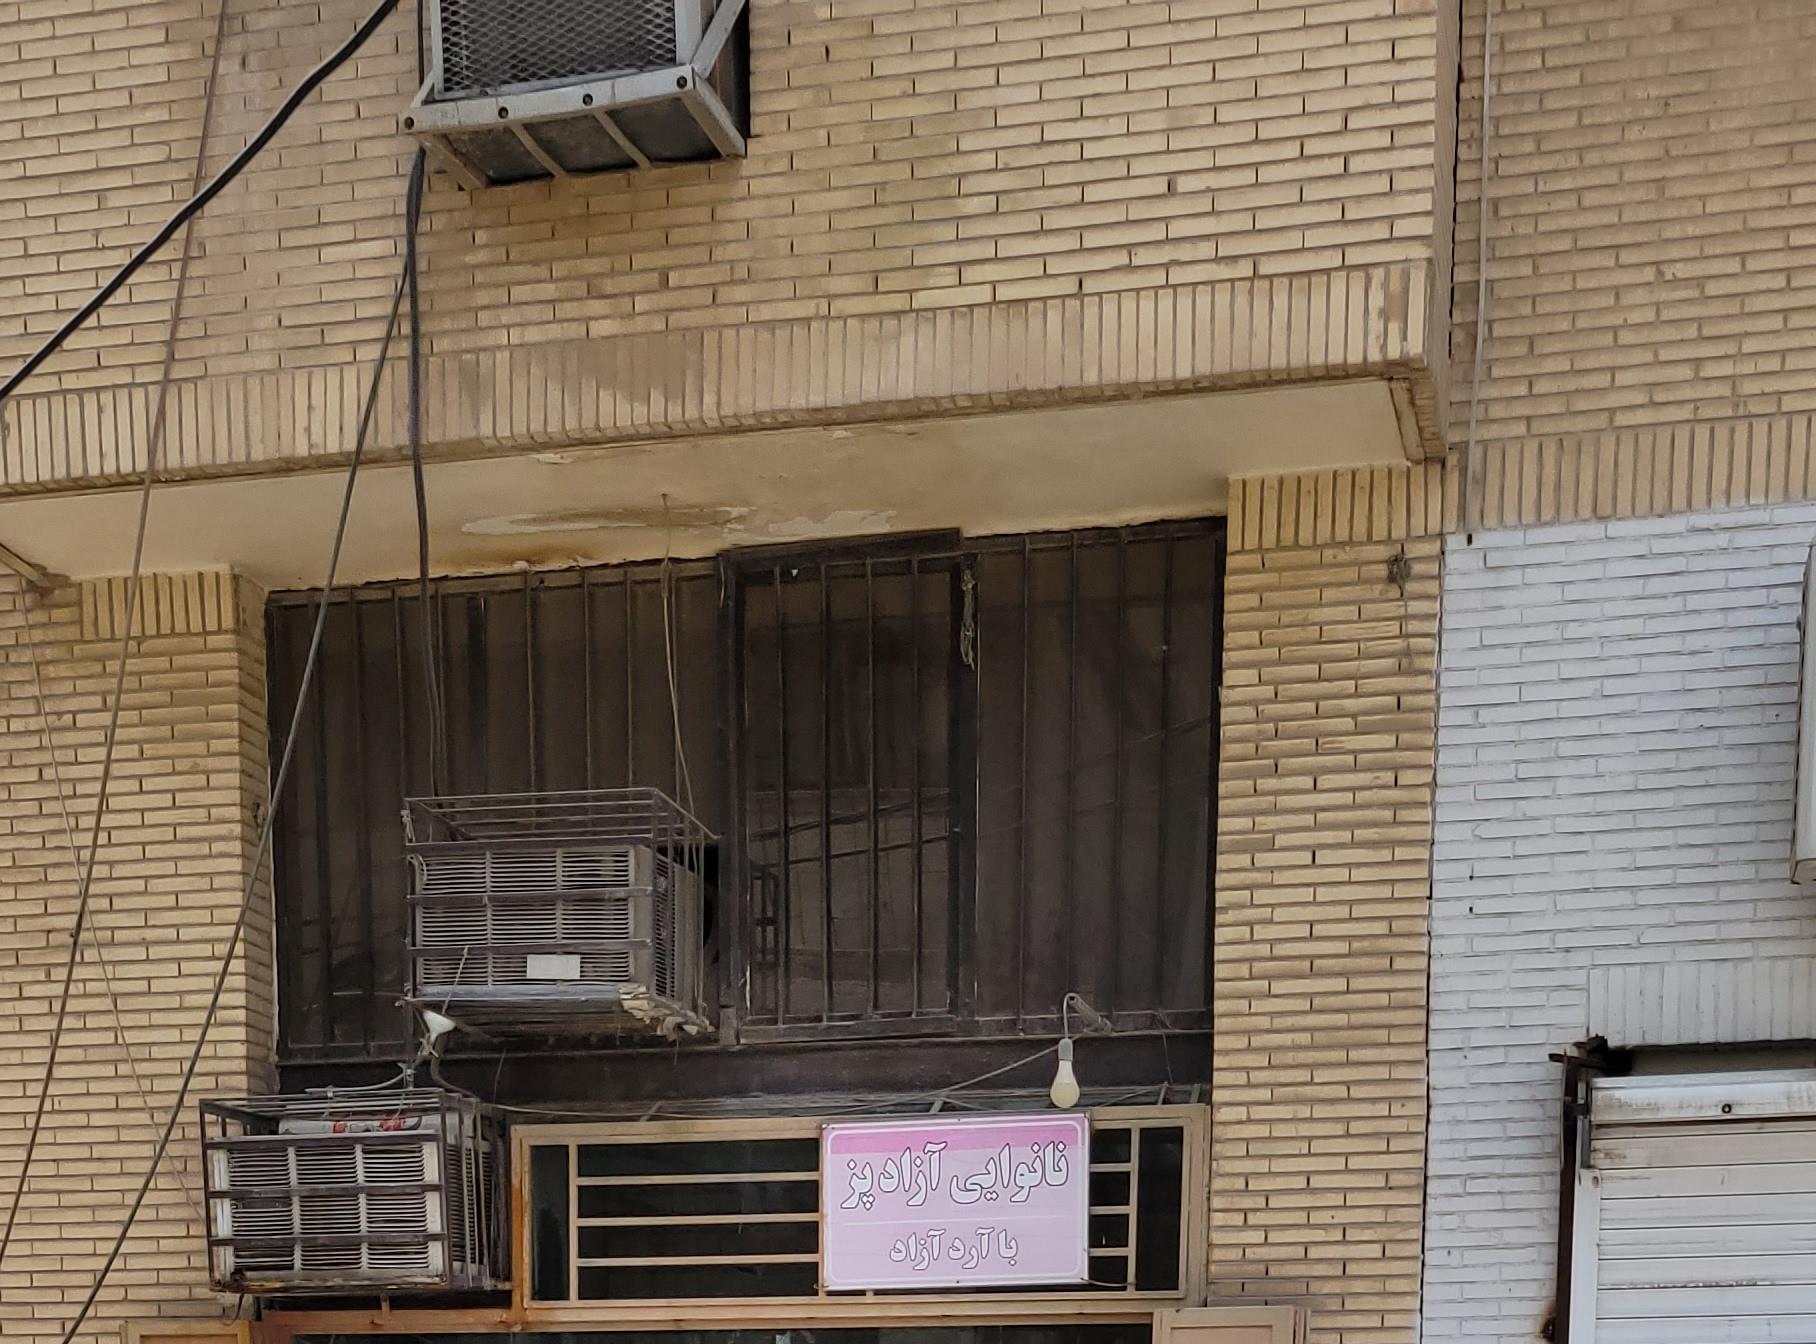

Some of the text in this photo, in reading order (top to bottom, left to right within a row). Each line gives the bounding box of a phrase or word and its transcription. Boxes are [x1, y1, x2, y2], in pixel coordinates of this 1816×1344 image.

[950, 1141, 1069, 1204] نانوایی
[889, 1227, 1018, 1270] با آرد آزاد
